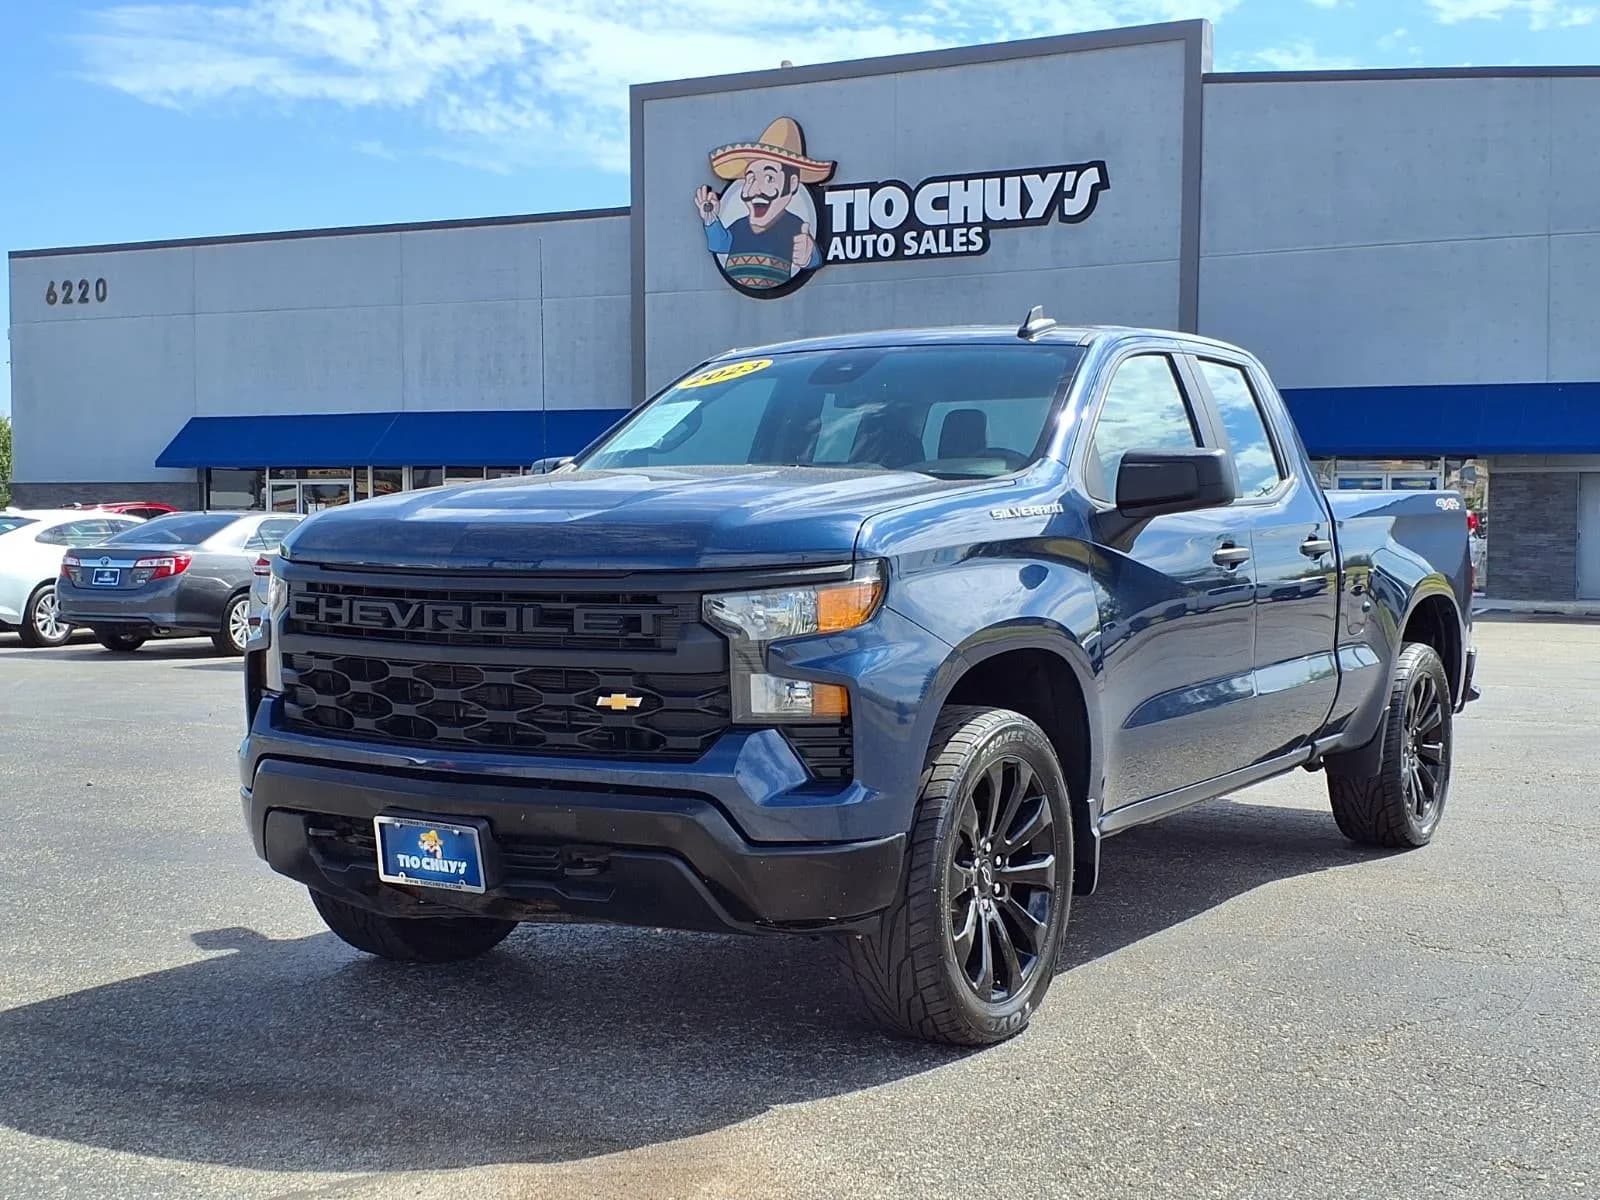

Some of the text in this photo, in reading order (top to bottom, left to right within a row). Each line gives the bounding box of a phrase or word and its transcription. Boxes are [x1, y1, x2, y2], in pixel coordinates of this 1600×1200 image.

[825, 167, 1100, 233] TIO CHUY'S
[827, 227, 984, 260] AUTO SALES
[46, 278, 107, 305] 6220
[684, 361, 765, 386] 2023
[289, 594, 677, 635] CHEVROLET
[397, 853, 420, 869] TIO
